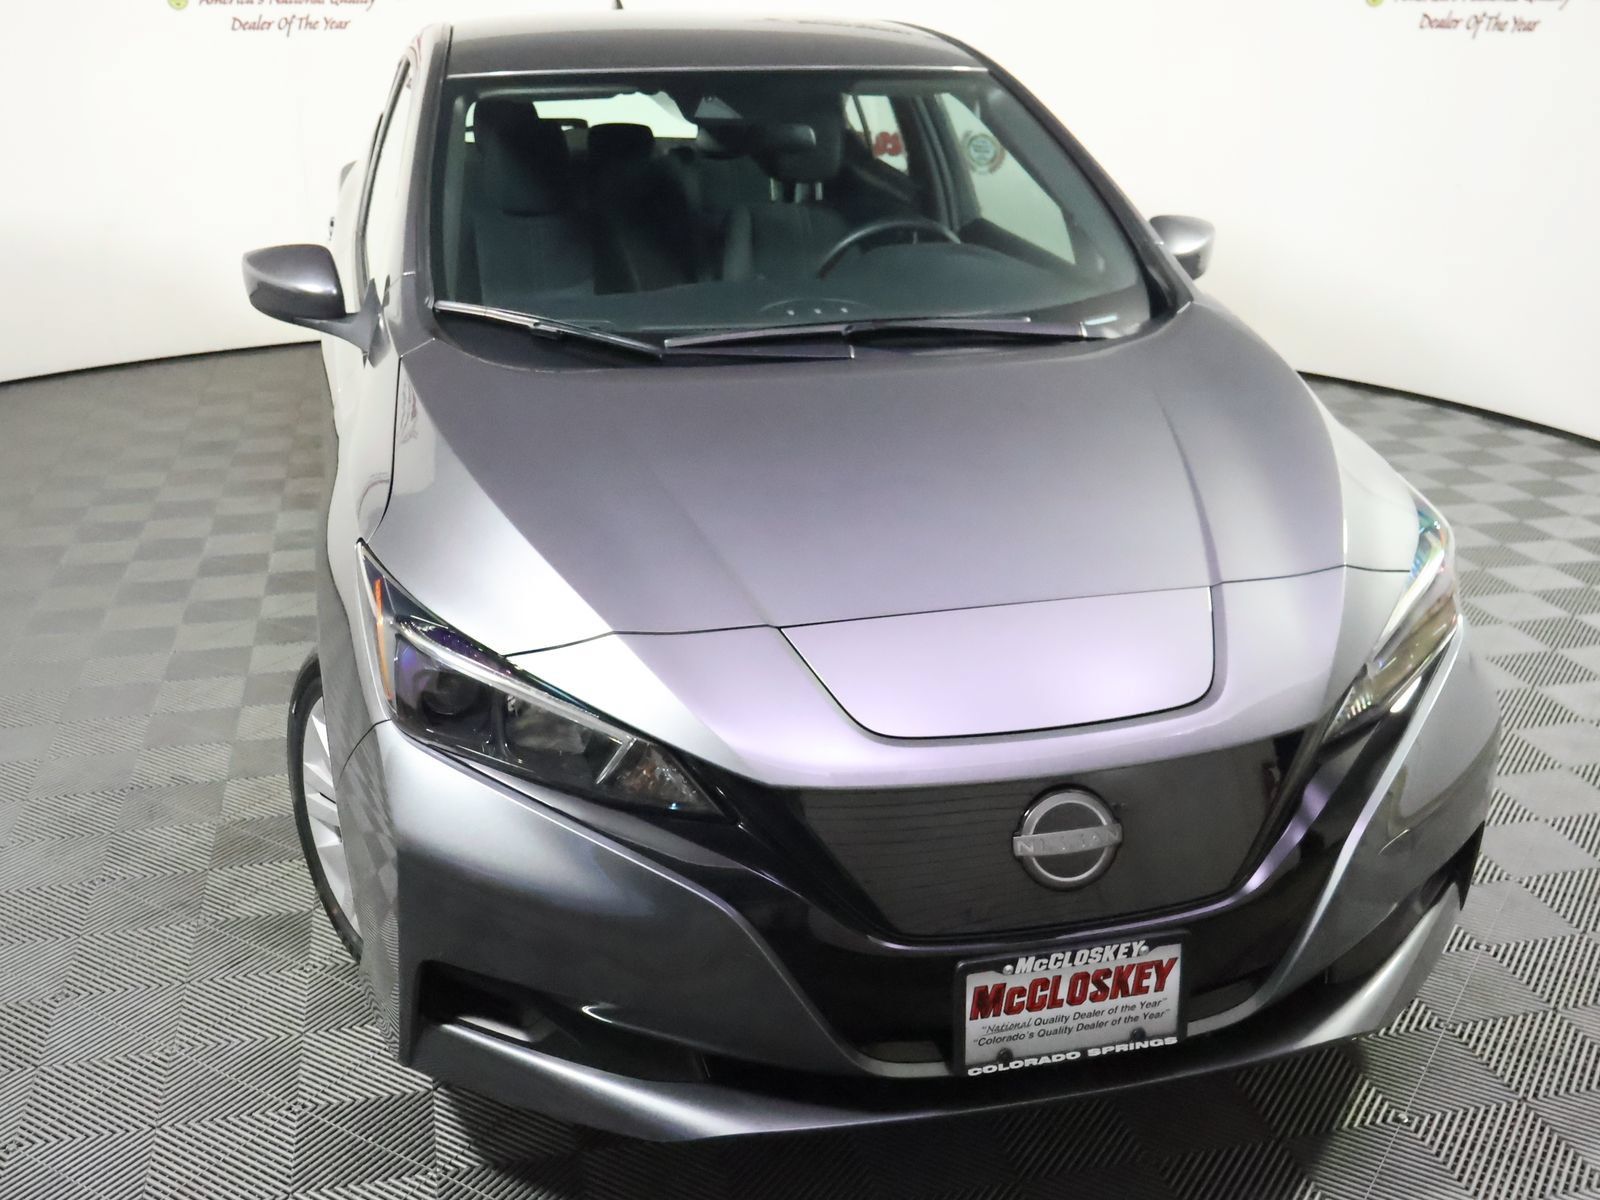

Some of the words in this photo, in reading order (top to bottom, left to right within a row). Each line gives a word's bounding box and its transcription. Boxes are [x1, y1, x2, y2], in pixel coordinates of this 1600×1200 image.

[231, 14, 274, 31] Dealer
[277, 14, 296, 37] Of
[298, 13, 320, 31] The
[323, 16, 351, 31] Year
[1014, 940, 1146, 974] McCLOSKEY
[969, 957, 1178, 1020] McCLOSKEY
[1034, 1014, 1070, 1027] Quality
[1072, 1009, 1105, 1021] Dealer
[1107, 1005, 1119, 1015] of
[1120, 1003, 1136, 1013] the
[1037, 1024, 1073, 1038] Quality
[1076, 1020, 1109, 1032] Dealer
[1111, 1016, 1122, 1026] of
[1123, 1014, 1139, 1024] the
[967, 1051, 1081, 1076] COLORADO
[1087, 1036, 1178, 1057] SPRINGS
